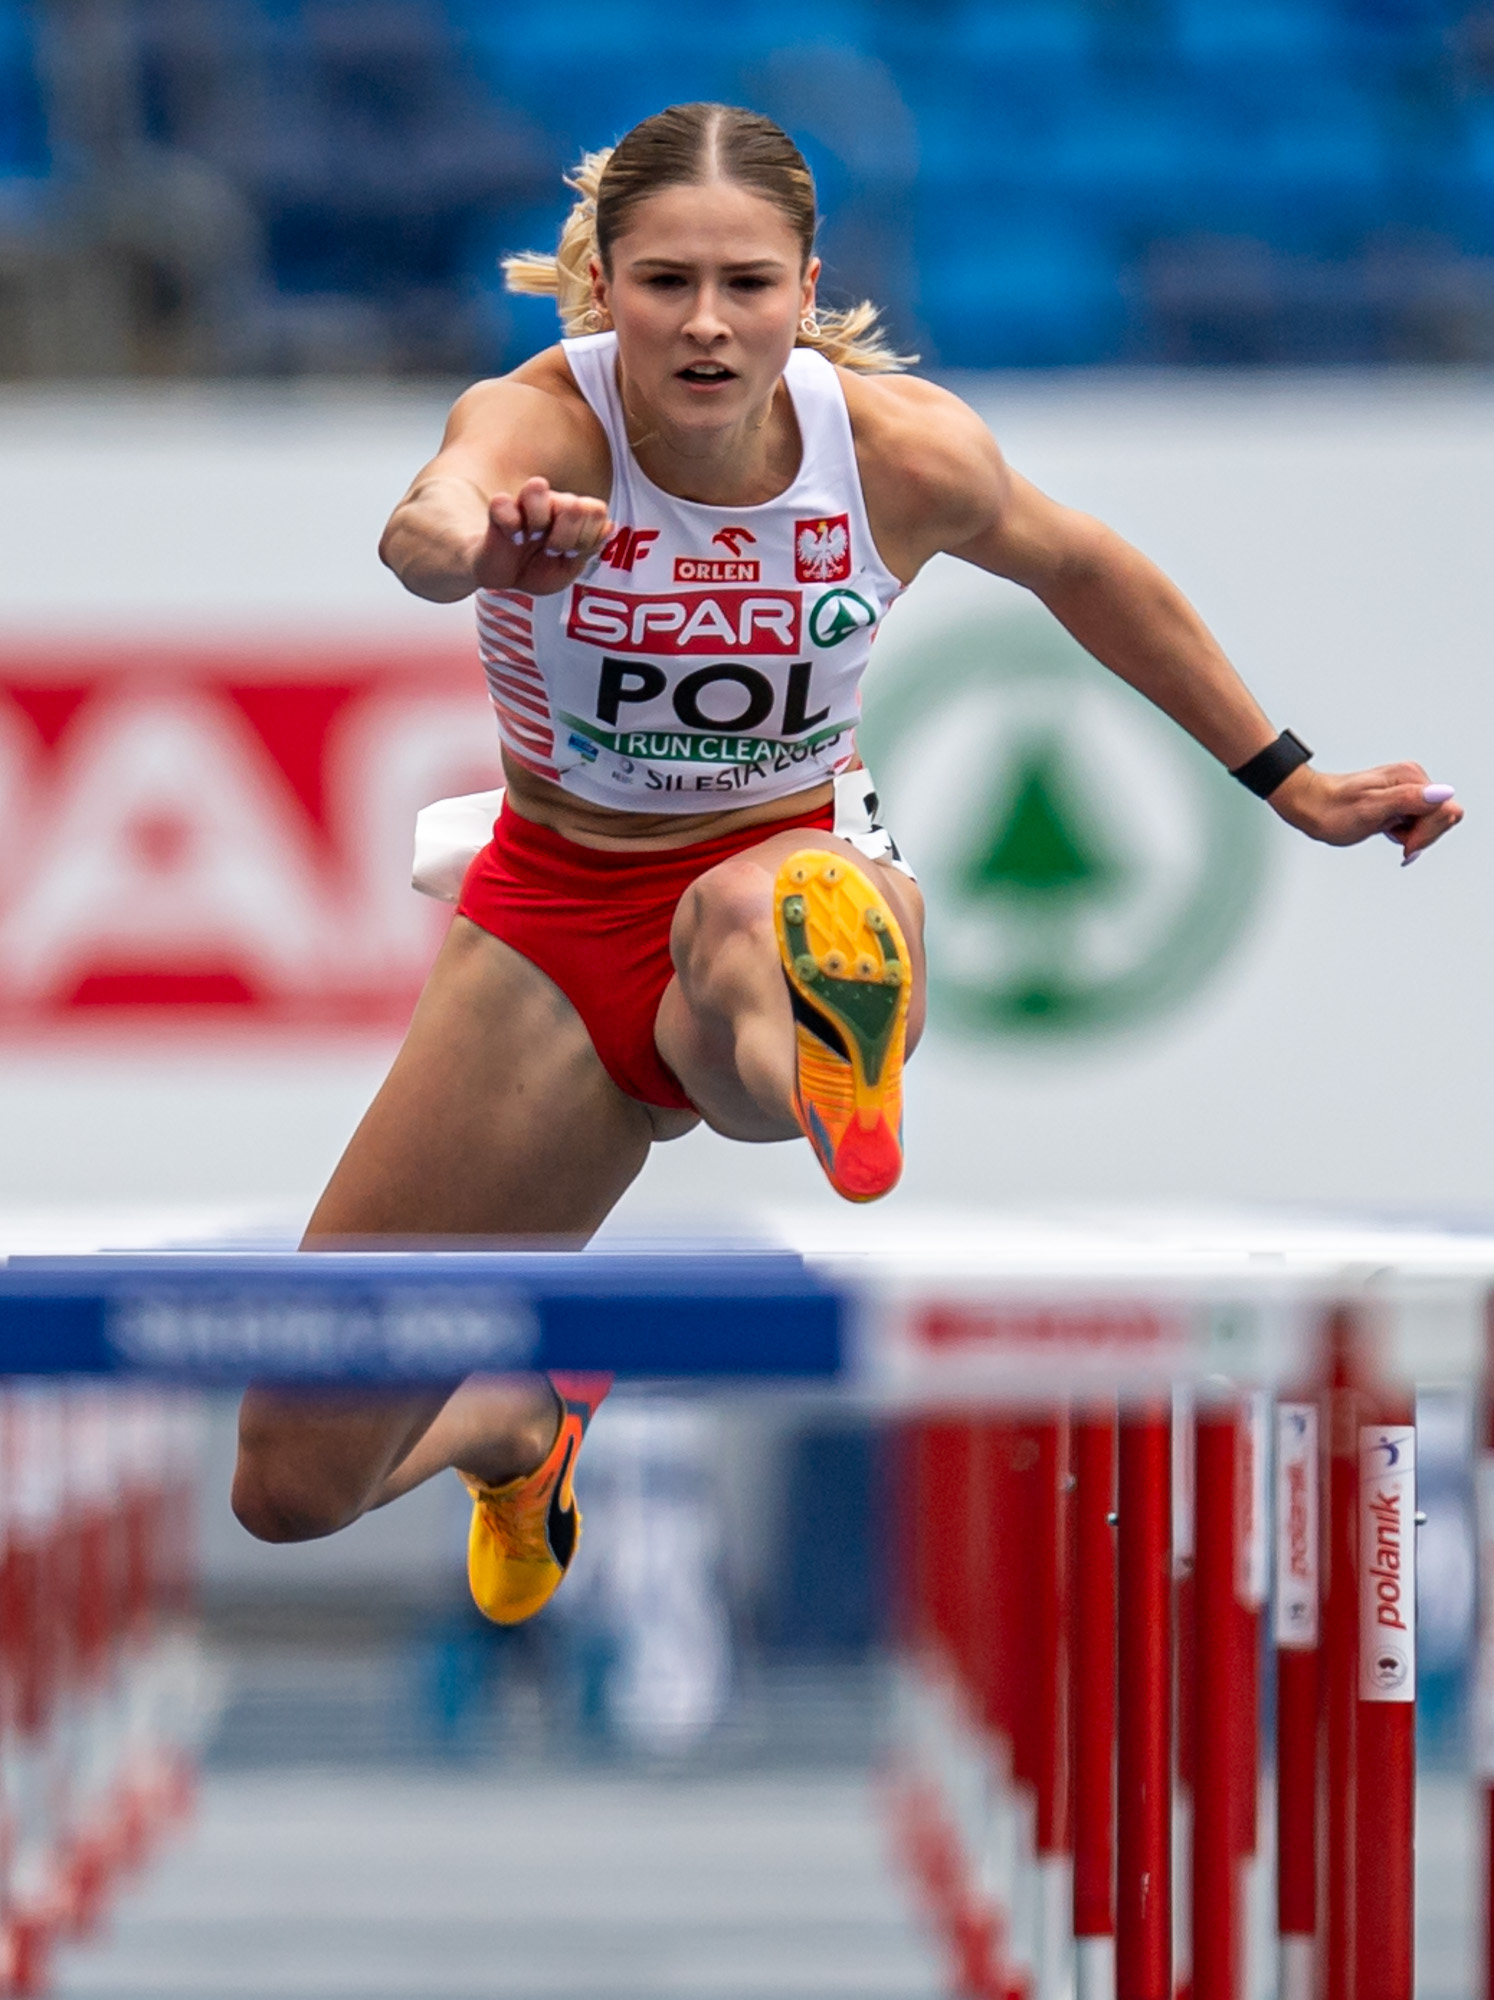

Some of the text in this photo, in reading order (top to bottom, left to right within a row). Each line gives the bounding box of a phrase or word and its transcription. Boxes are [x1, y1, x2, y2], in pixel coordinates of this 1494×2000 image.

[678, 561, 755, 581] ORLEN
[574, 596, 796, 646] SPAR
[596, 656, 831, 736] POL
[628, 733, 692, 758] RUN
[645, 761, 767, 791] SILESIA
[1369, 1491, 1407, 1630] polanik
